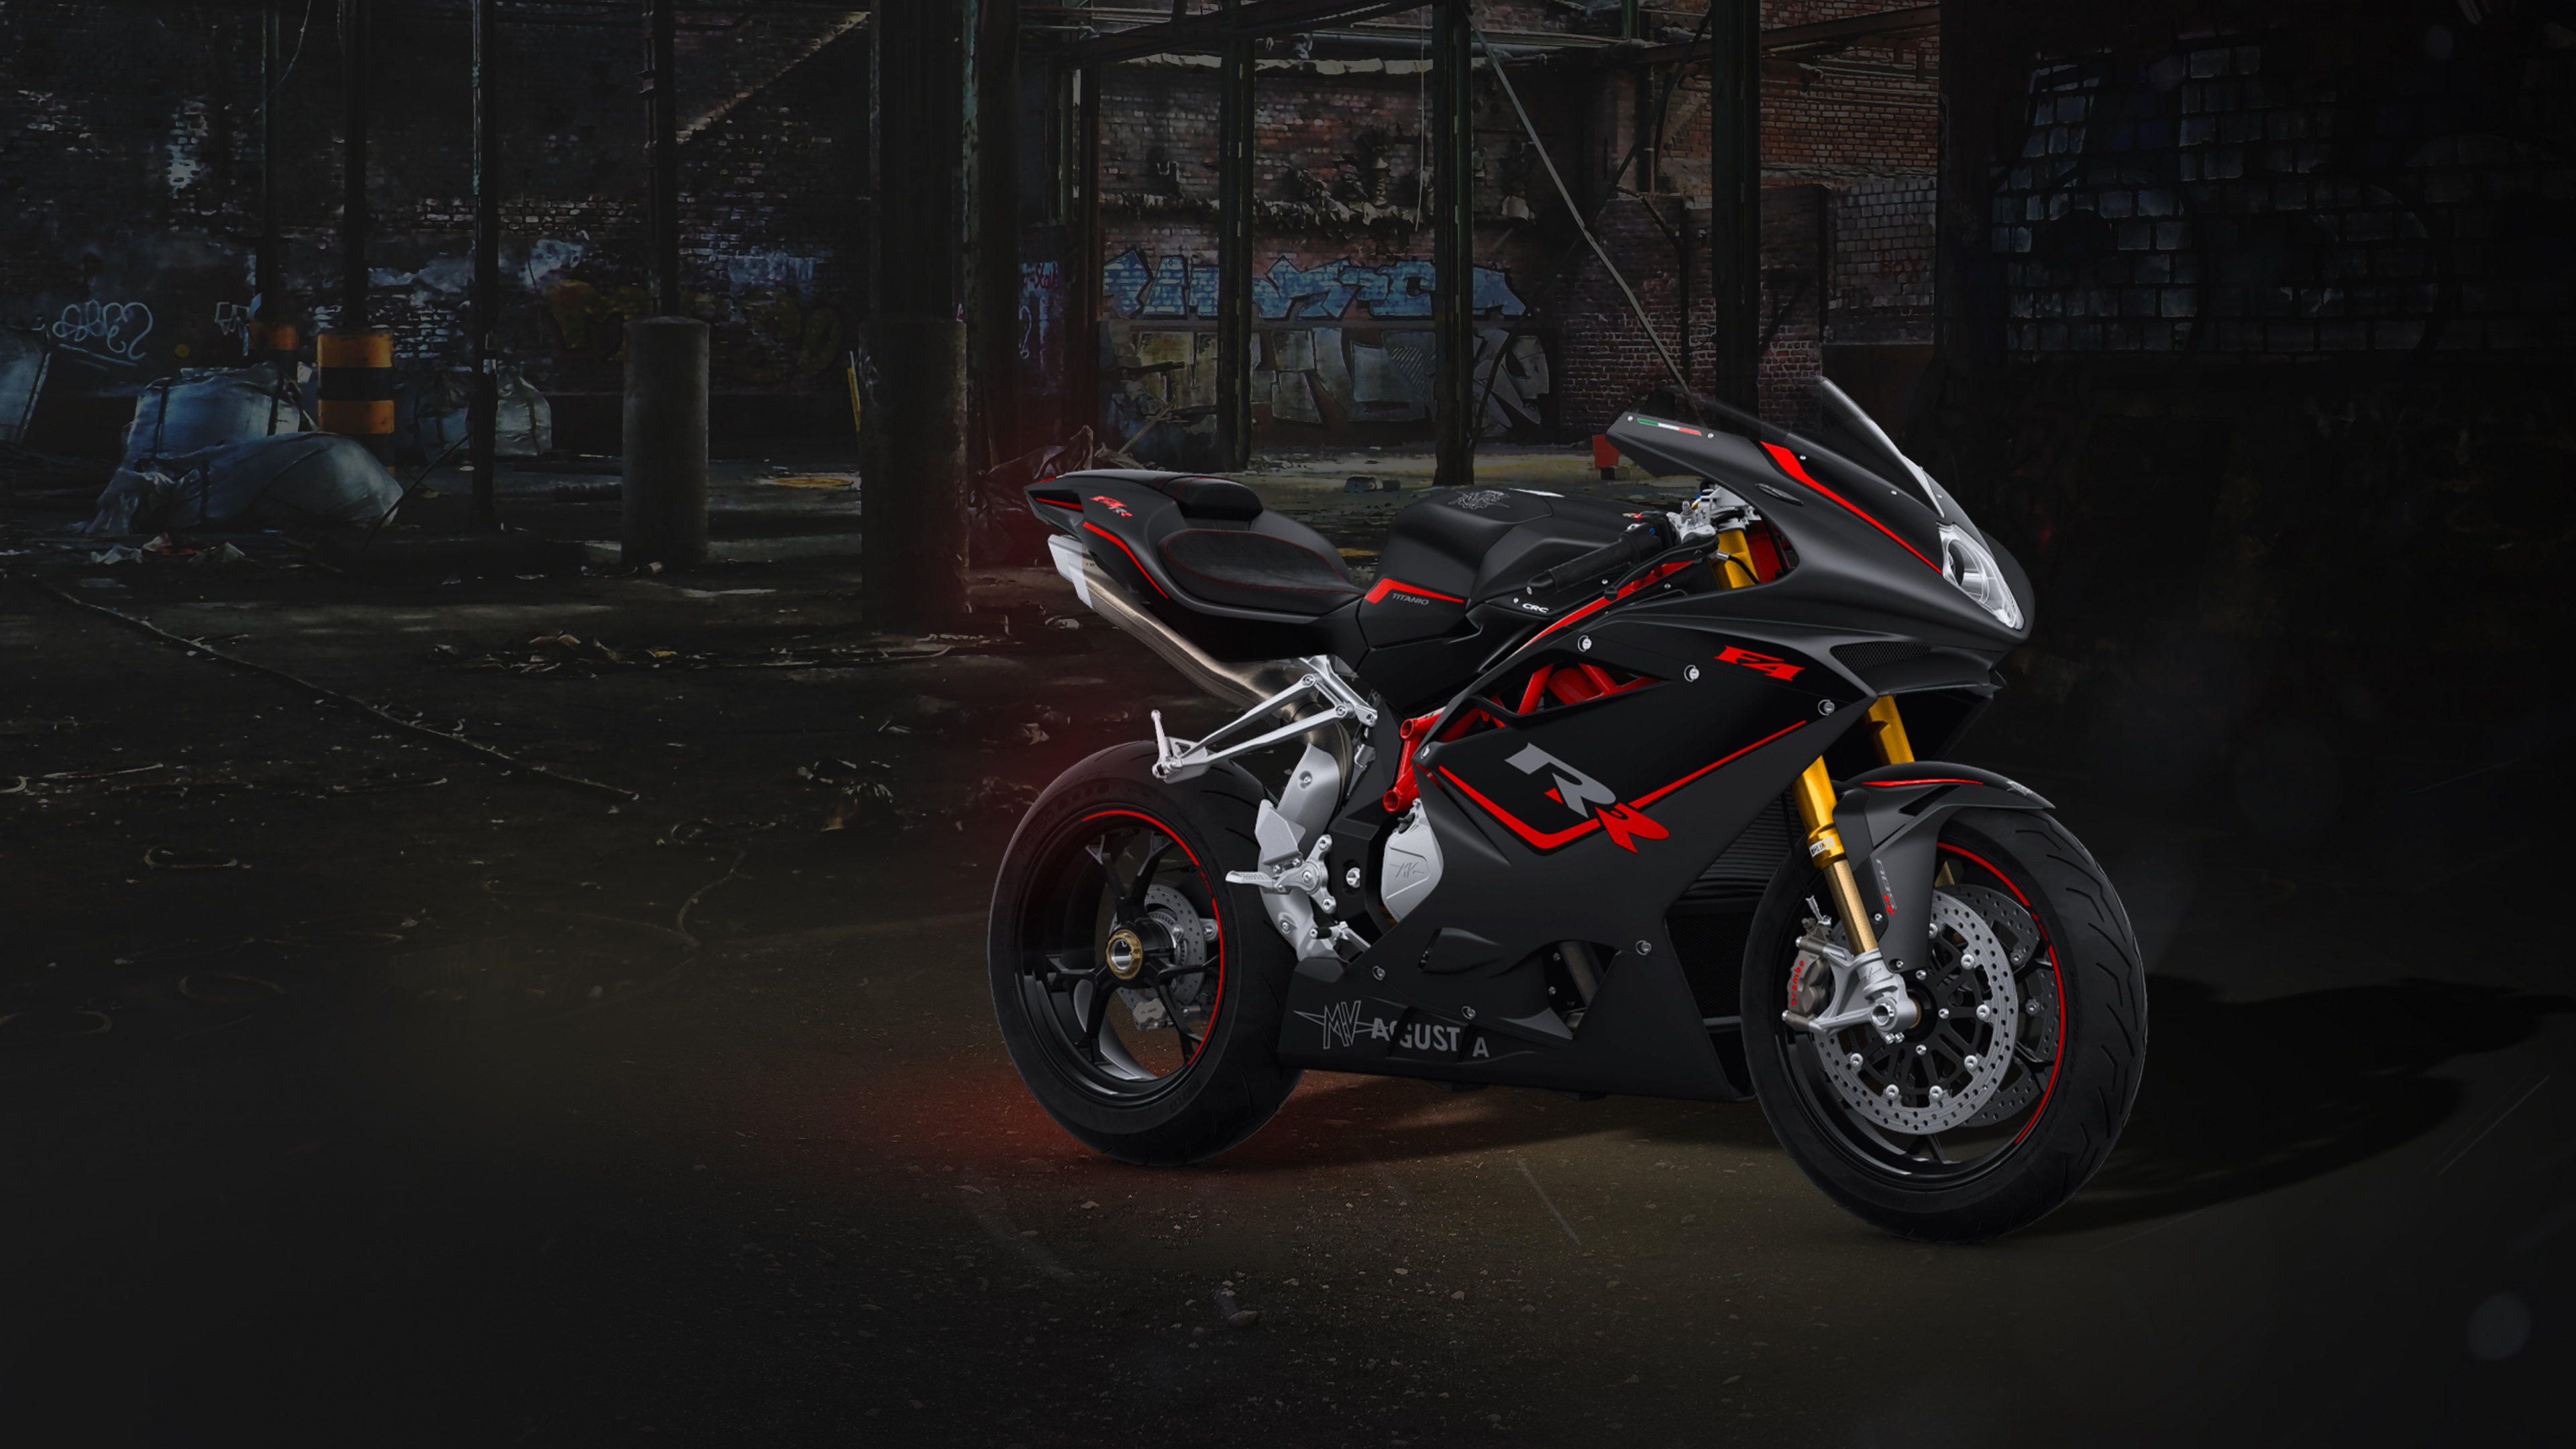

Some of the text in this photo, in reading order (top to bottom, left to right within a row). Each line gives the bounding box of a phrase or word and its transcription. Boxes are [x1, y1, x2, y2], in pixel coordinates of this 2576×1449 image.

[1391, 592, 1430, 606] TITANIO
[1522, 602, 1550, 614] CRC
[1713, 645, 1807, 682] F4
[1790, 959, 1805, 1005] brembo
